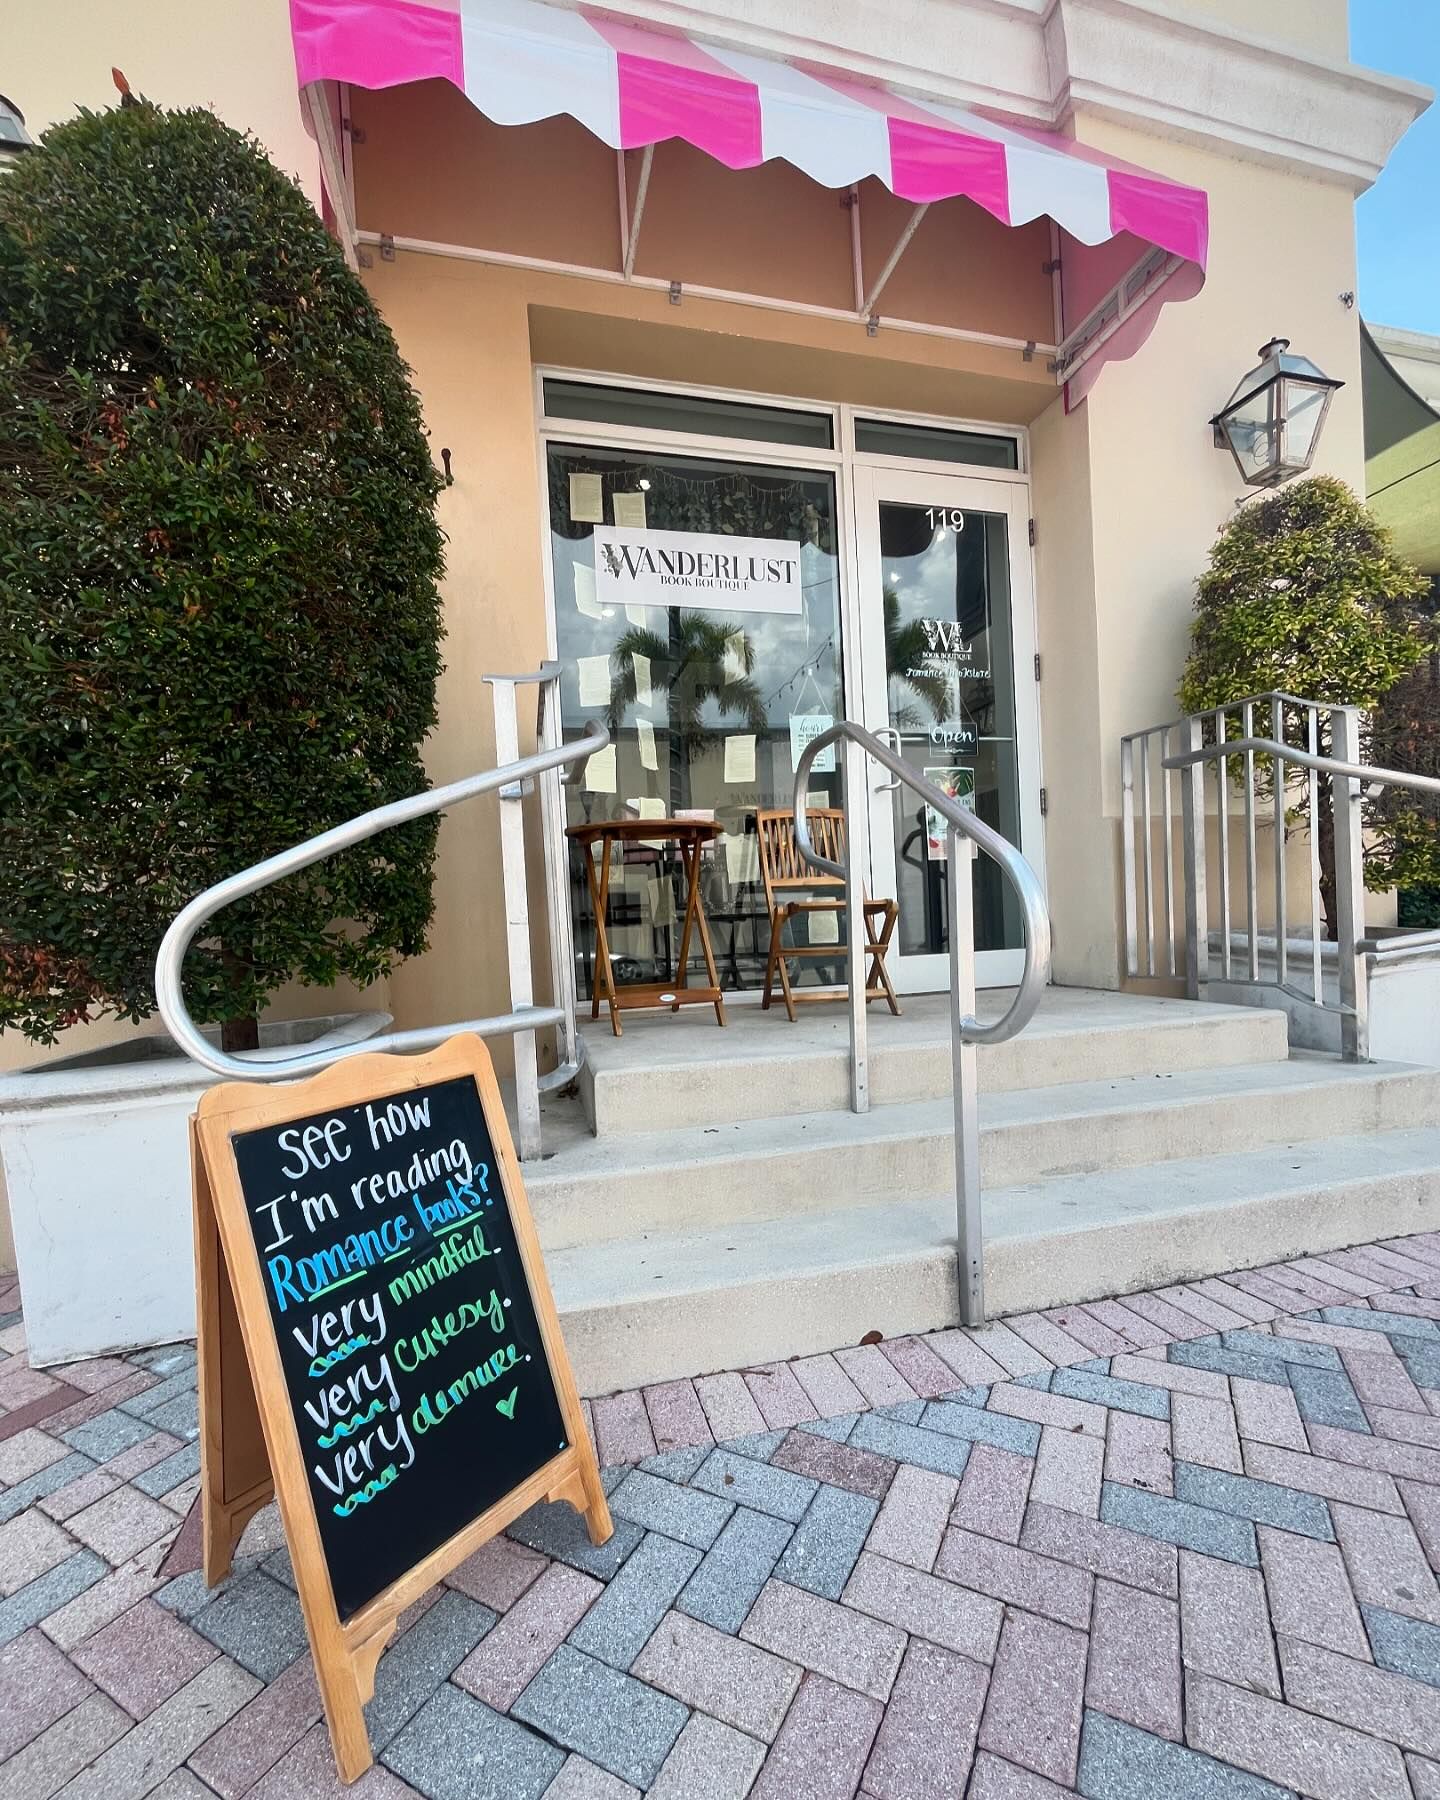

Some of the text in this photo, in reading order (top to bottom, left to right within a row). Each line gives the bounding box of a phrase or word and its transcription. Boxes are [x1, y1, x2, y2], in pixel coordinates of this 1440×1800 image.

[925, 508, 964, 533] 119
[600, 543, 797, 584] WANDERLUST
[660, 575, 751, 592] BOOK BOUTIQUE
[922, 651, 973, 661] BOOK BOUTIQUE
[931, 726, 976, 748] Open
[365, 1097, 431, 1151] how
[255, 1138, 473, 1253] I'm reading
[267, 1162, 494, 1312] Romance books?
[292, 1224, 502, 1358] very mindful.
[303, 1353, 400, 1429] very
[314, 1343, 532, 1496] very demure.
